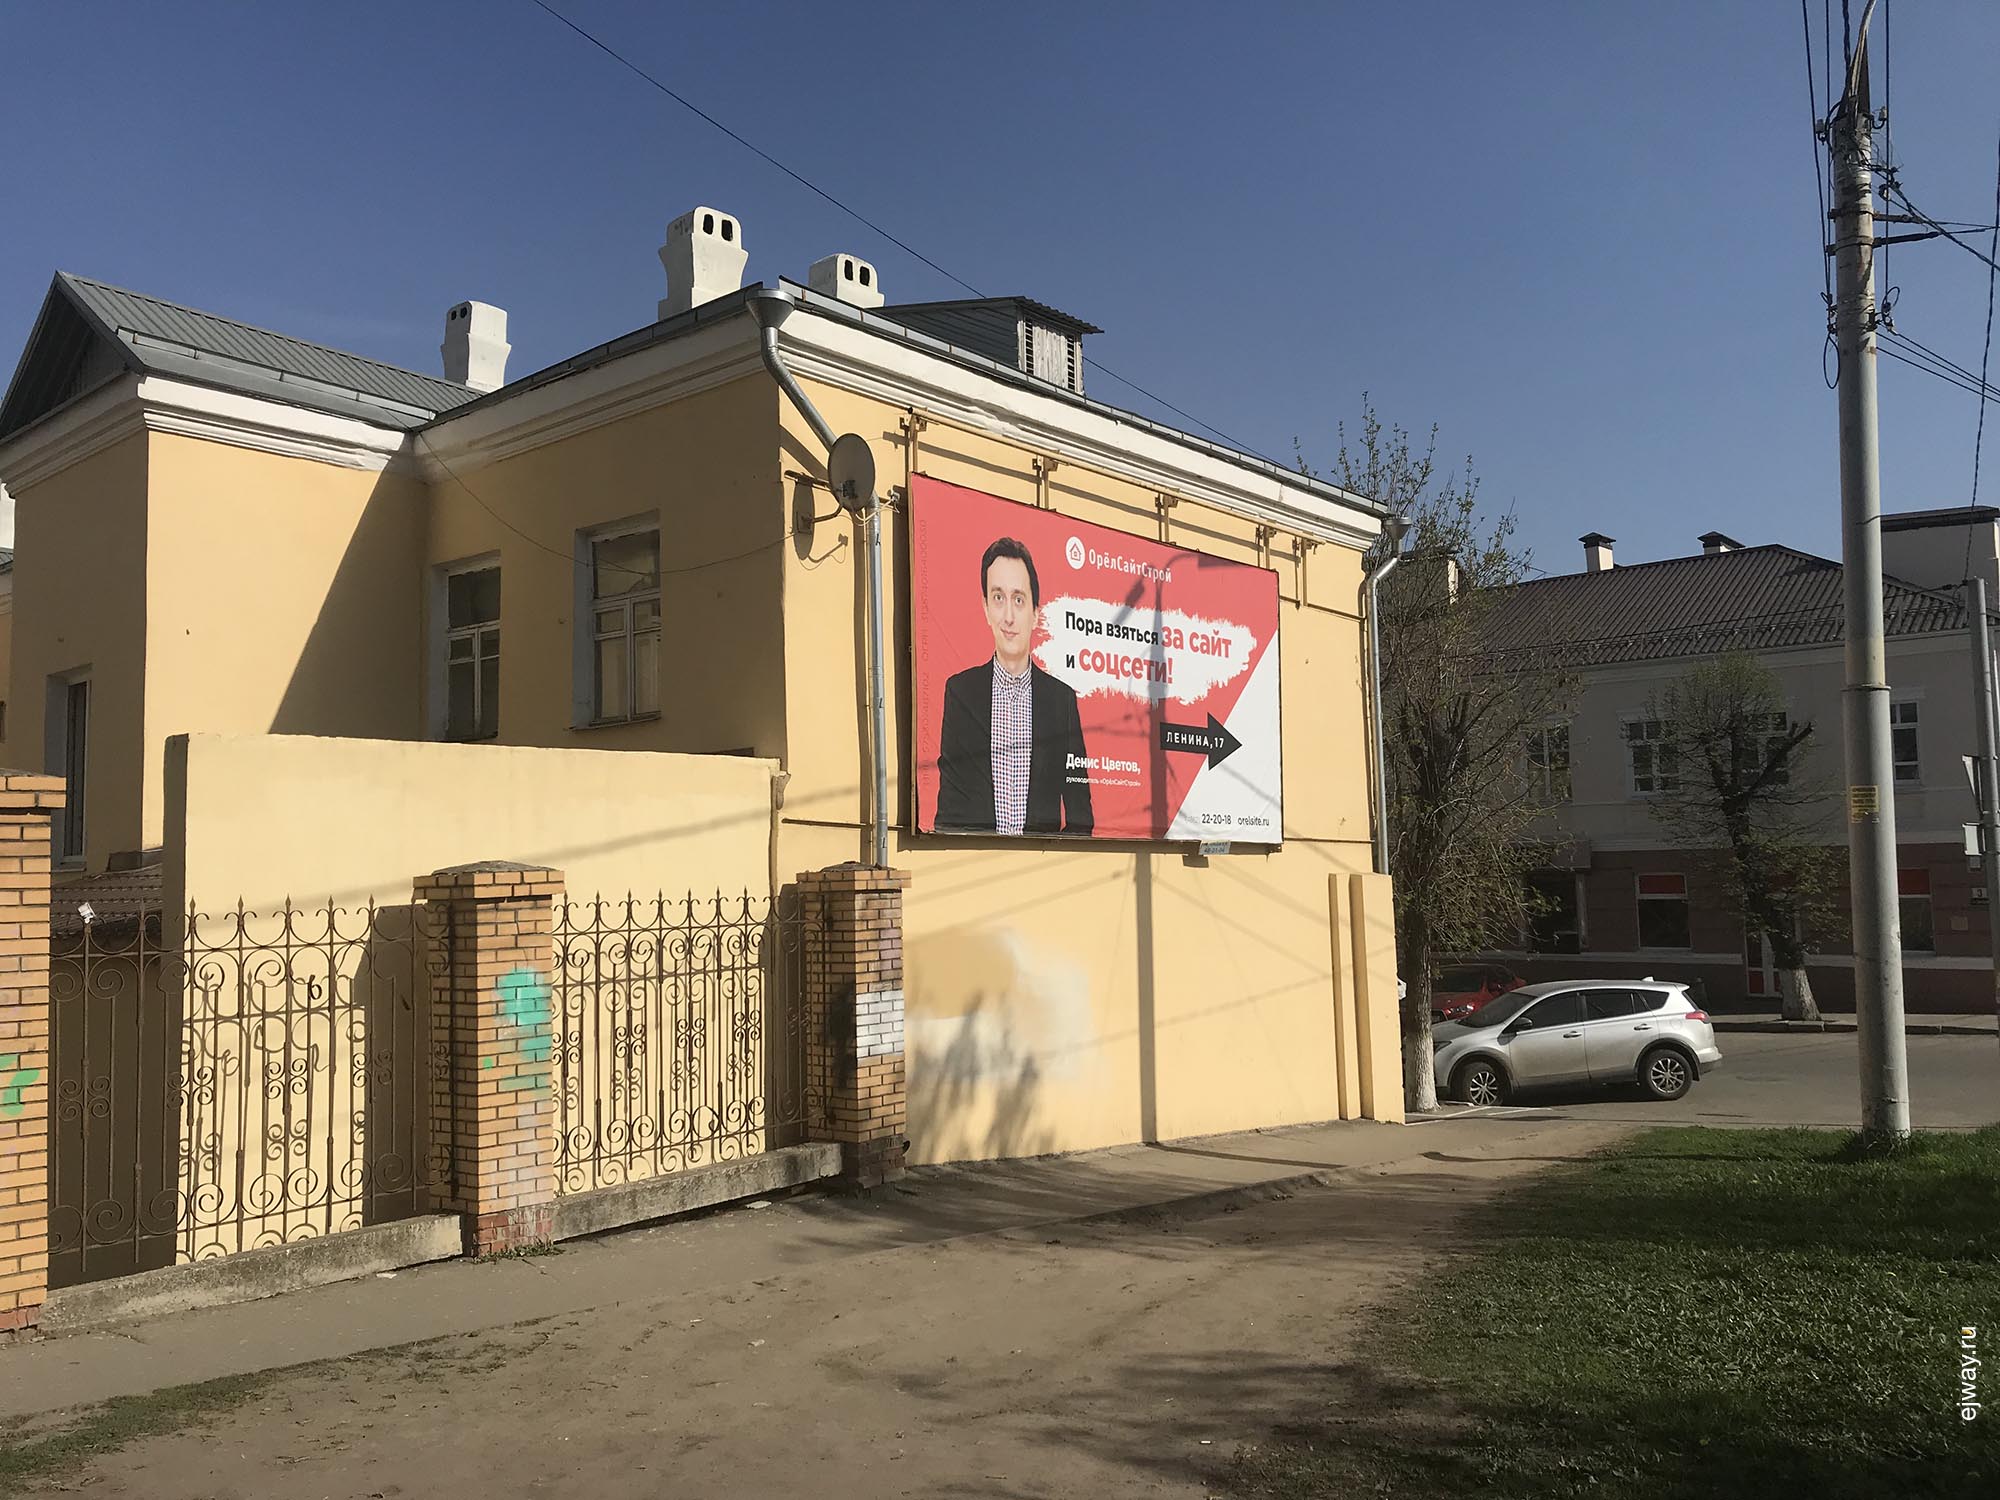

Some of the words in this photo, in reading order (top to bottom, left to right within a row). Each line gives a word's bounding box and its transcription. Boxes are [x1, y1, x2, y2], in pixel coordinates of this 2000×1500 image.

[1088, 548, 1172, 583] ОрёлСайтСтрой
[1065, 611, 1102, 636] Пора
[1106, 622, 1159, 645] взяться
[1161, 625, 1184, 650] за
[1189, 629, 1232, 658] сайт
[1066, 654, 1075, 669] и
[1078, 648, 1174, 684] соцсети!
[1065, 753, 1100, 770] Денис
[1101, 756, 1141, 775] Цветов,
[1065, 776, 1099, 784] руководитель
[1201, 813, 1232, 825] 22-20-18
[1237, 816, 1270, 827] orelsite.ru
[1977, 889, 1983, 898] 3
